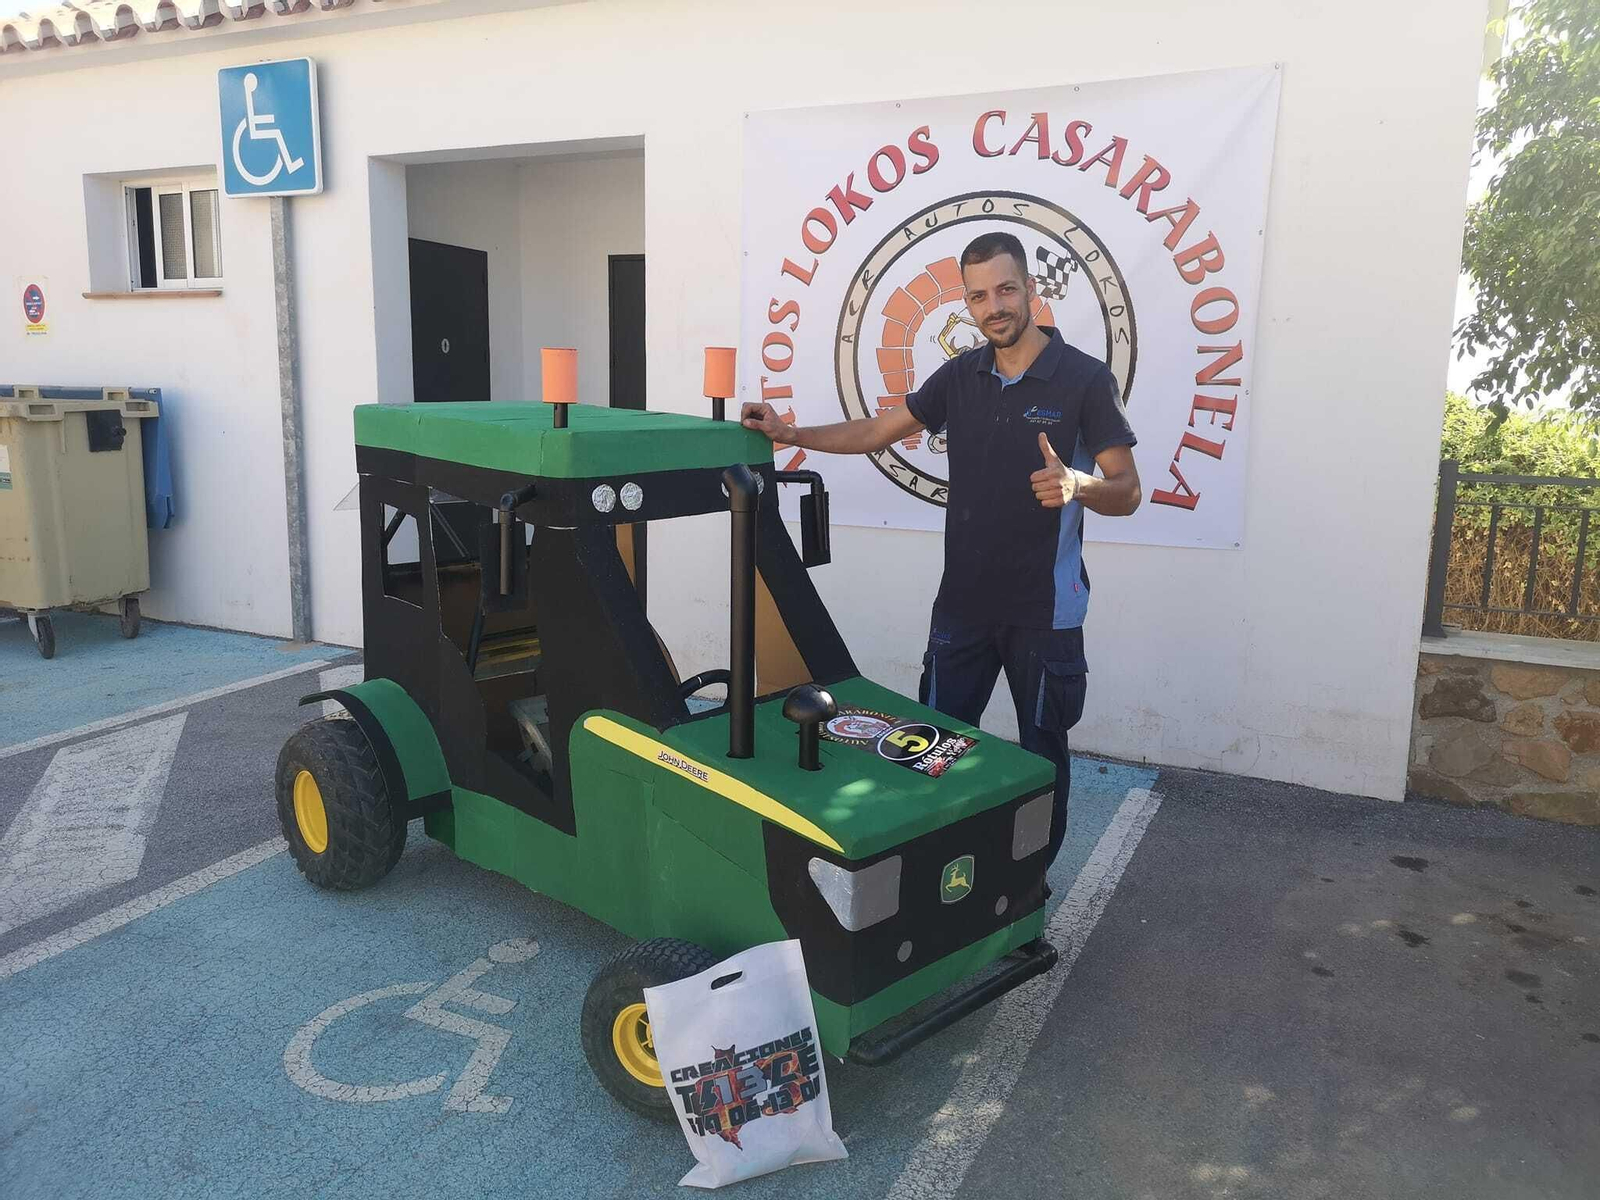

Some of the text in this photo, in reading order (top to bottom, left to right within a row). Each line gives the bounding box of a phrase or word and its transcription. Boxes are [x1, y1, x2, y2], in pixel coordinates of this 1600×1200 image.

[841, 198, 1130, 346] ACR AUTOS LOKOS
[781, 125, 940, 287] LOKOS
[972, 109, 1244, 511] CASARABONELA
[657, 750, 709, 782] JOHN DEERE
[885, 730, 930, 753] 5
[670, 1026, 813, 1082] CREACIONES
